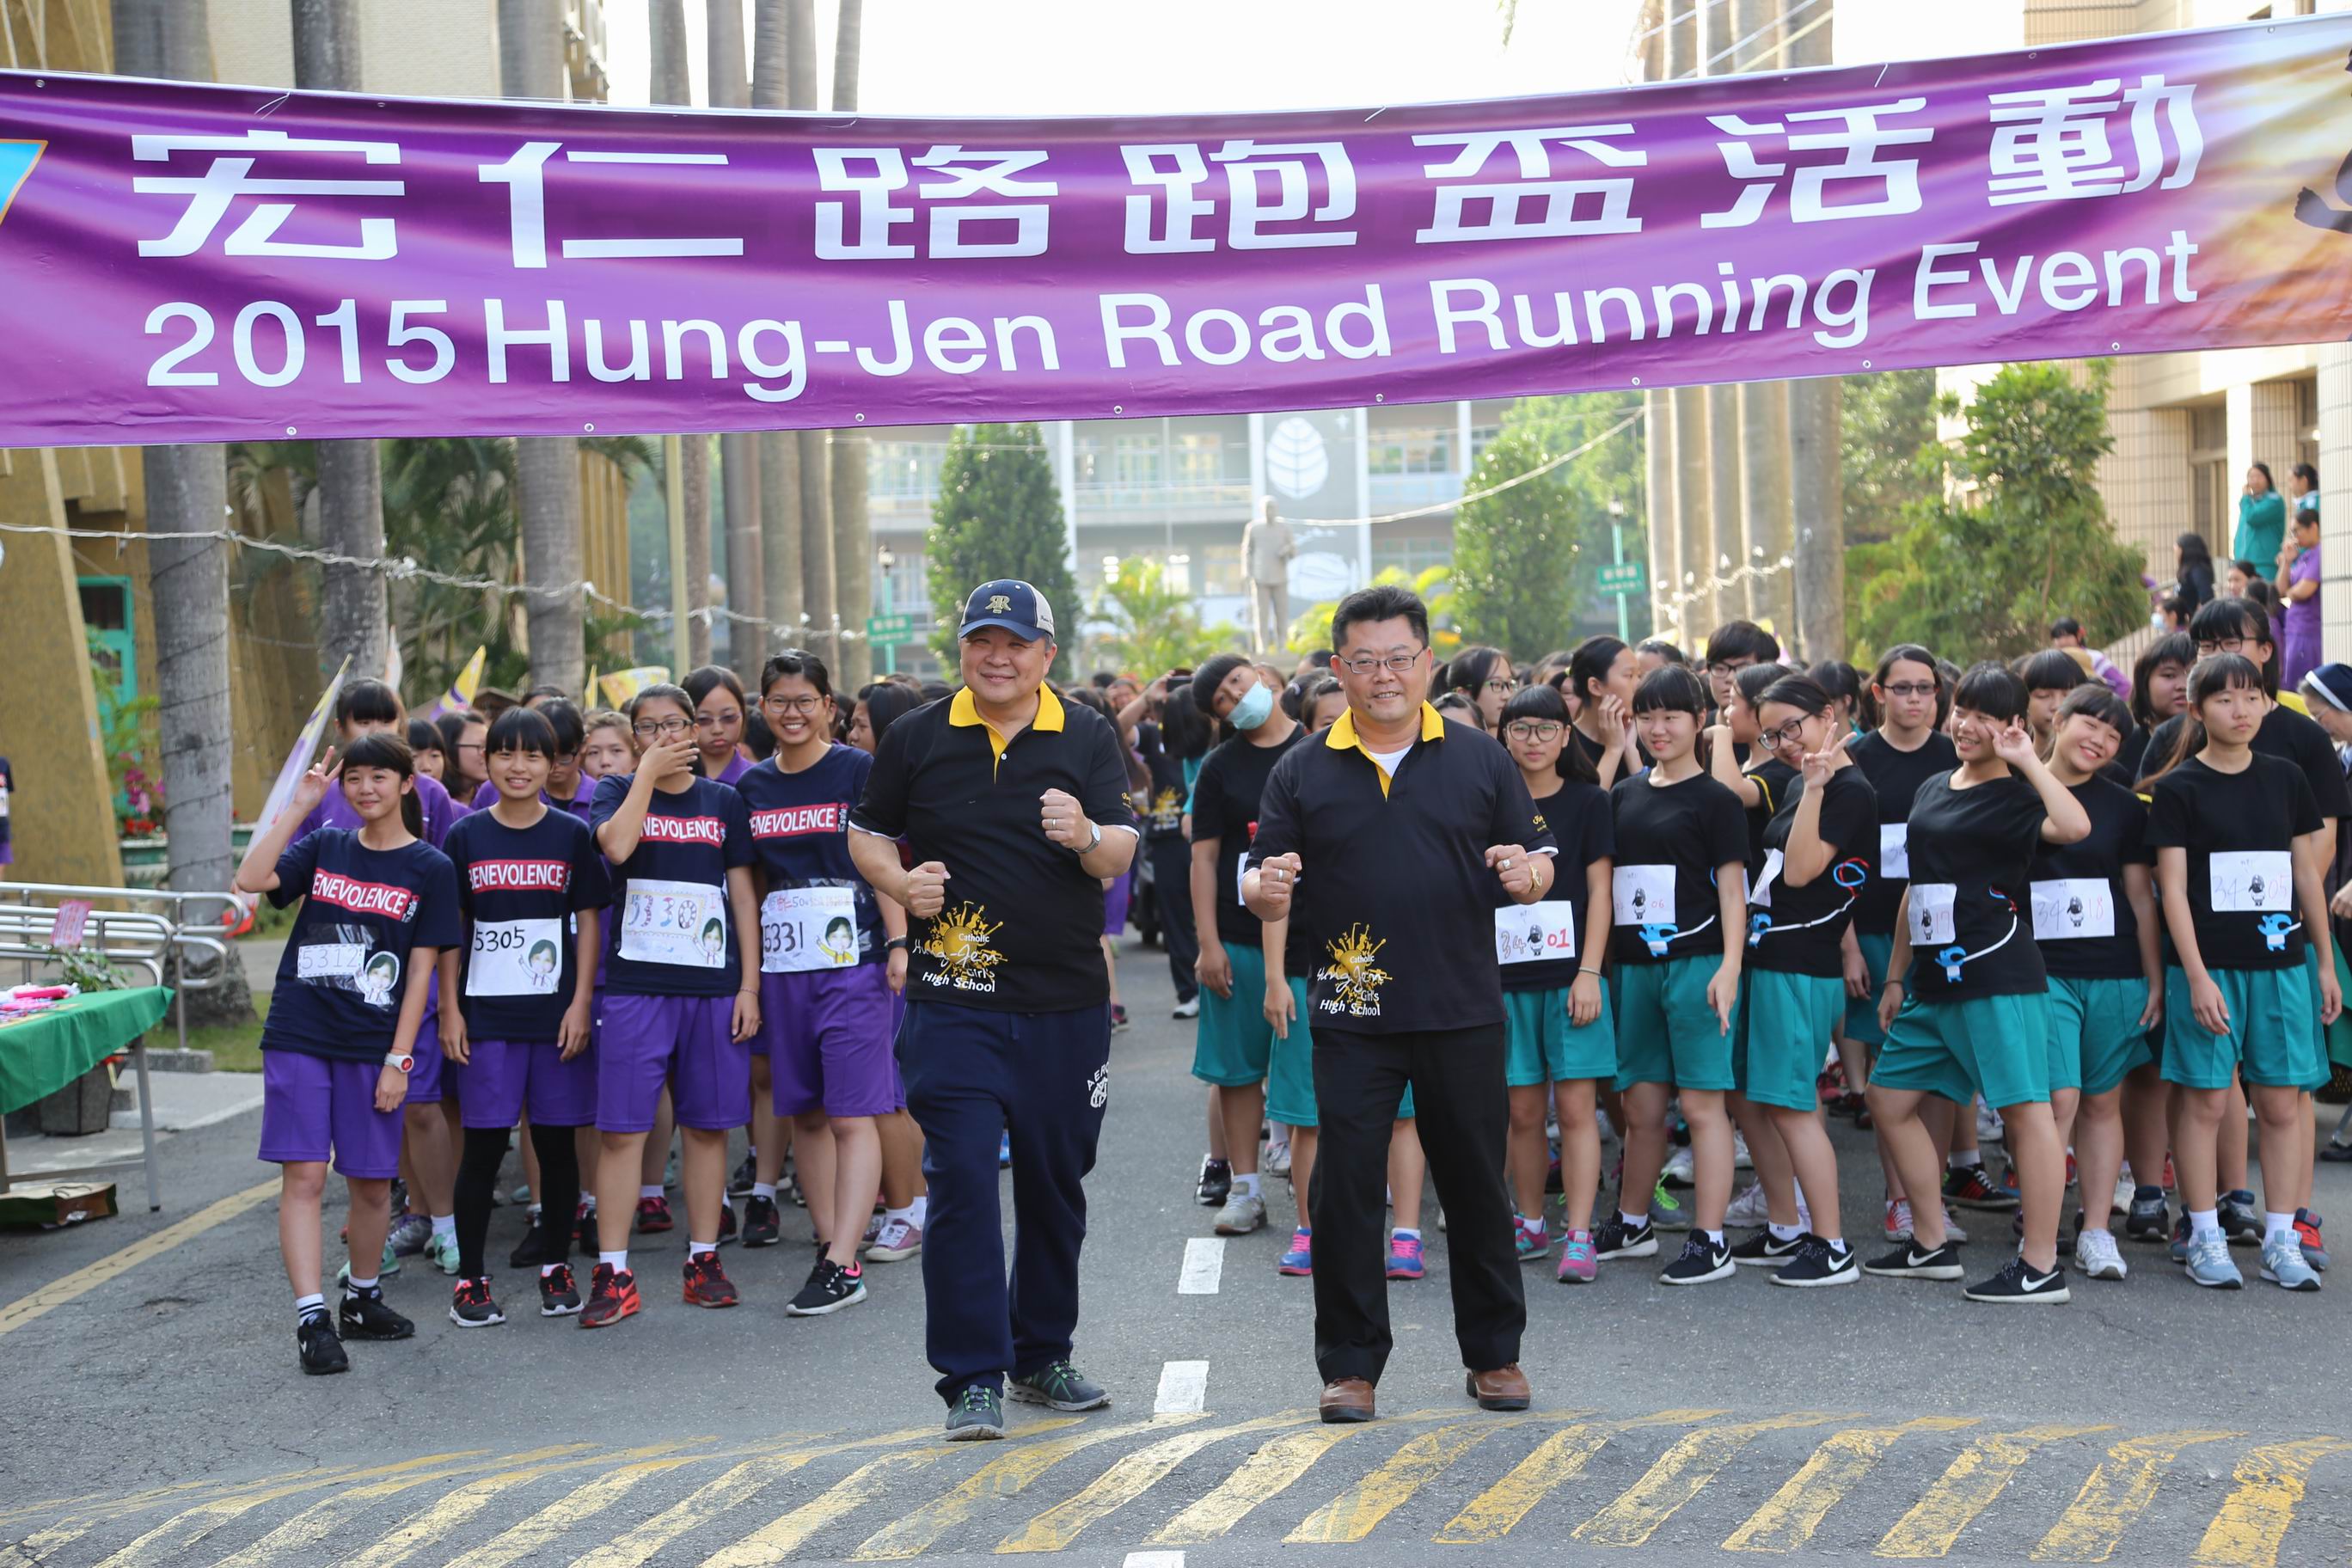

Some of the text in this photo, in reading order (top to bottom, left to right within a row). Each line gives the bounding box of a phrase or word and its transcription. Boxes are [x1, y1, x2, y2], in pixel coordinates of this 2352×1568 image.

[131, 73, 2205, 269] 宏仁路跑盃活動
[144, 230, 2199, 402] 2015 Hung-Jen Road Running Event
[640, 818, 720, 842] NEVOLENCE
[311, 873, 407, 915] ENEVOLENCE
[474, 926, 525, 952] 5305
[763, 921, 804, 954] 5331
[958, 933, 990, 943] Catholic
[301, 947, 359, 970] 5312
[1350, 954, 1375, 964] Catholic
[922, 971, 995, 993] High School
[1319, 999, 1381, 1016] High School
